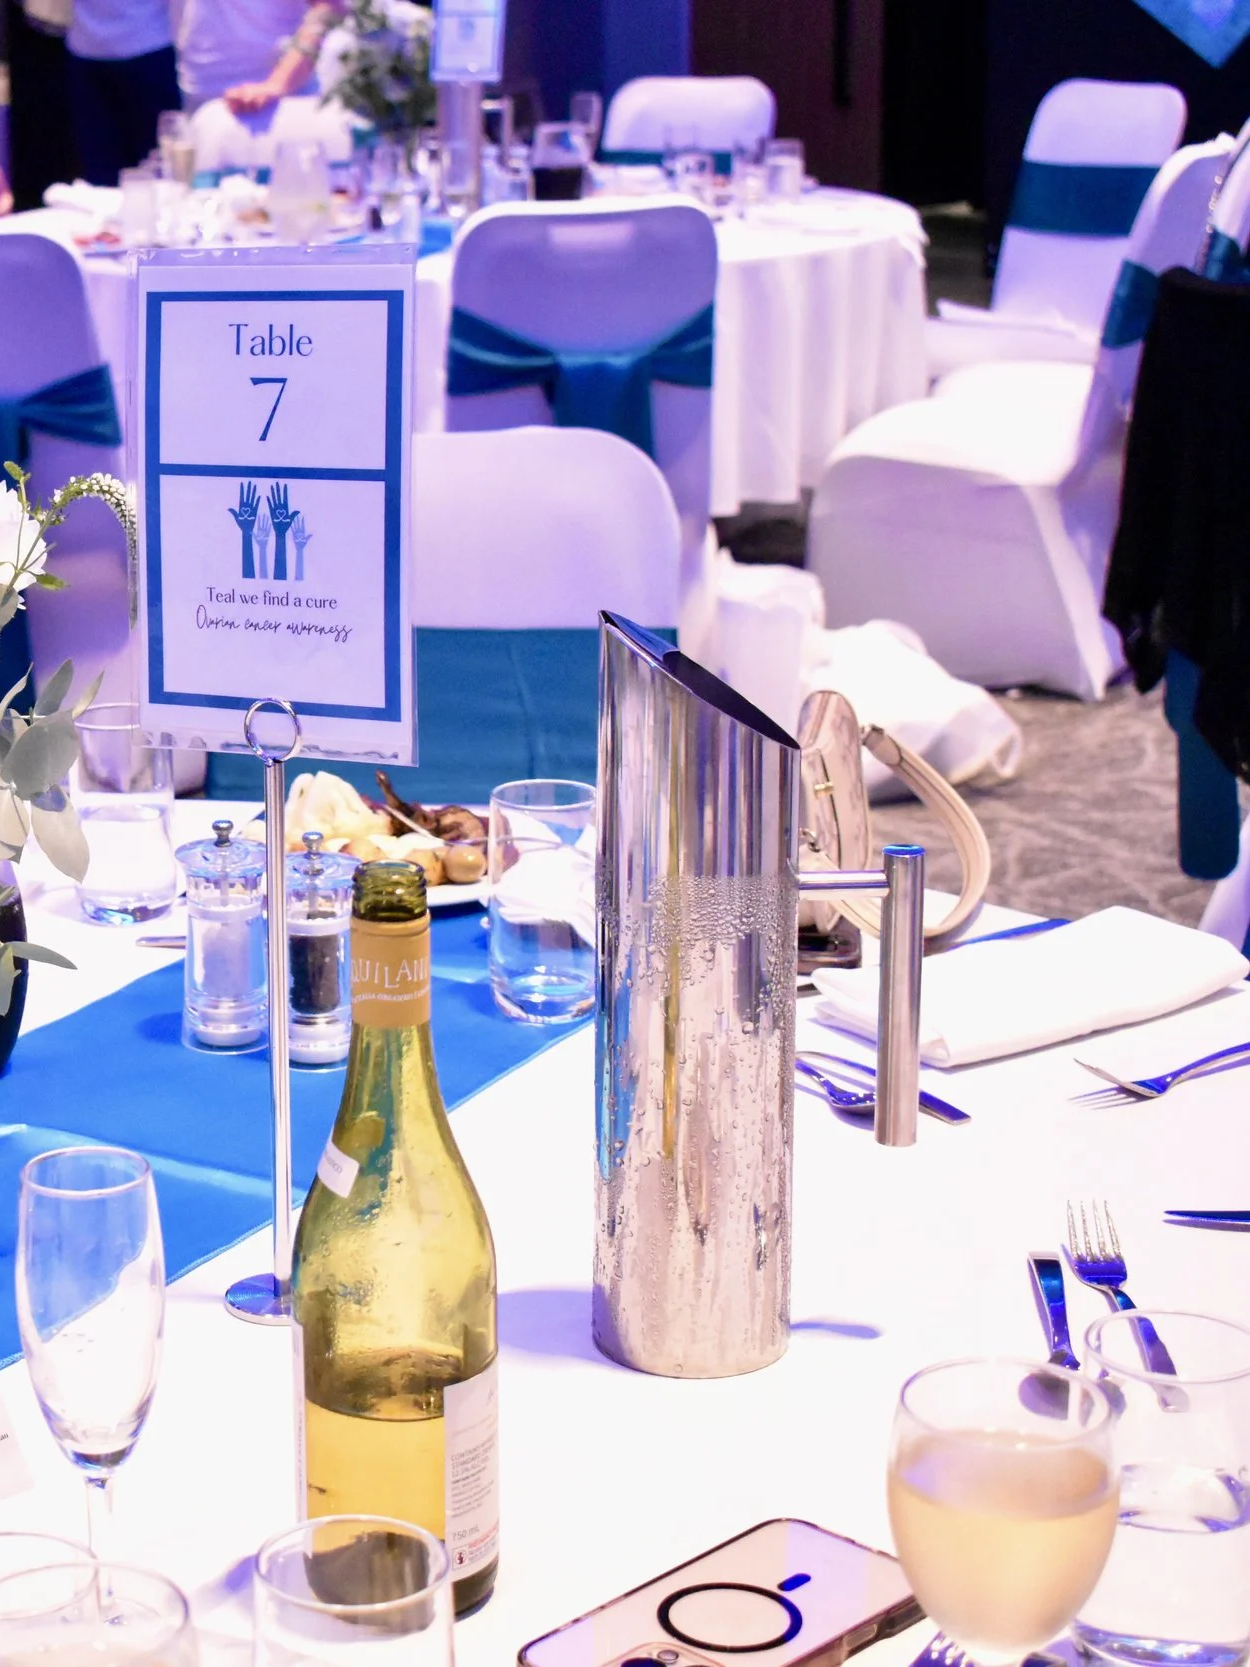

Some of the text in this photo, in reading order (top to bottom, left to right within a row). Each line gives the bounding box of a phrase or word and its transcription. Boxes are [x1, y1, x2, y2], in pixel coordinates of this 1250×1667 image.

[228, 322, 313, 358] Table
[249, 376, 288, 442] 7
[206, 586, 338, 610] Teal we find a cure
[196, 604, 354, 643] Ovarian cancer awareness
